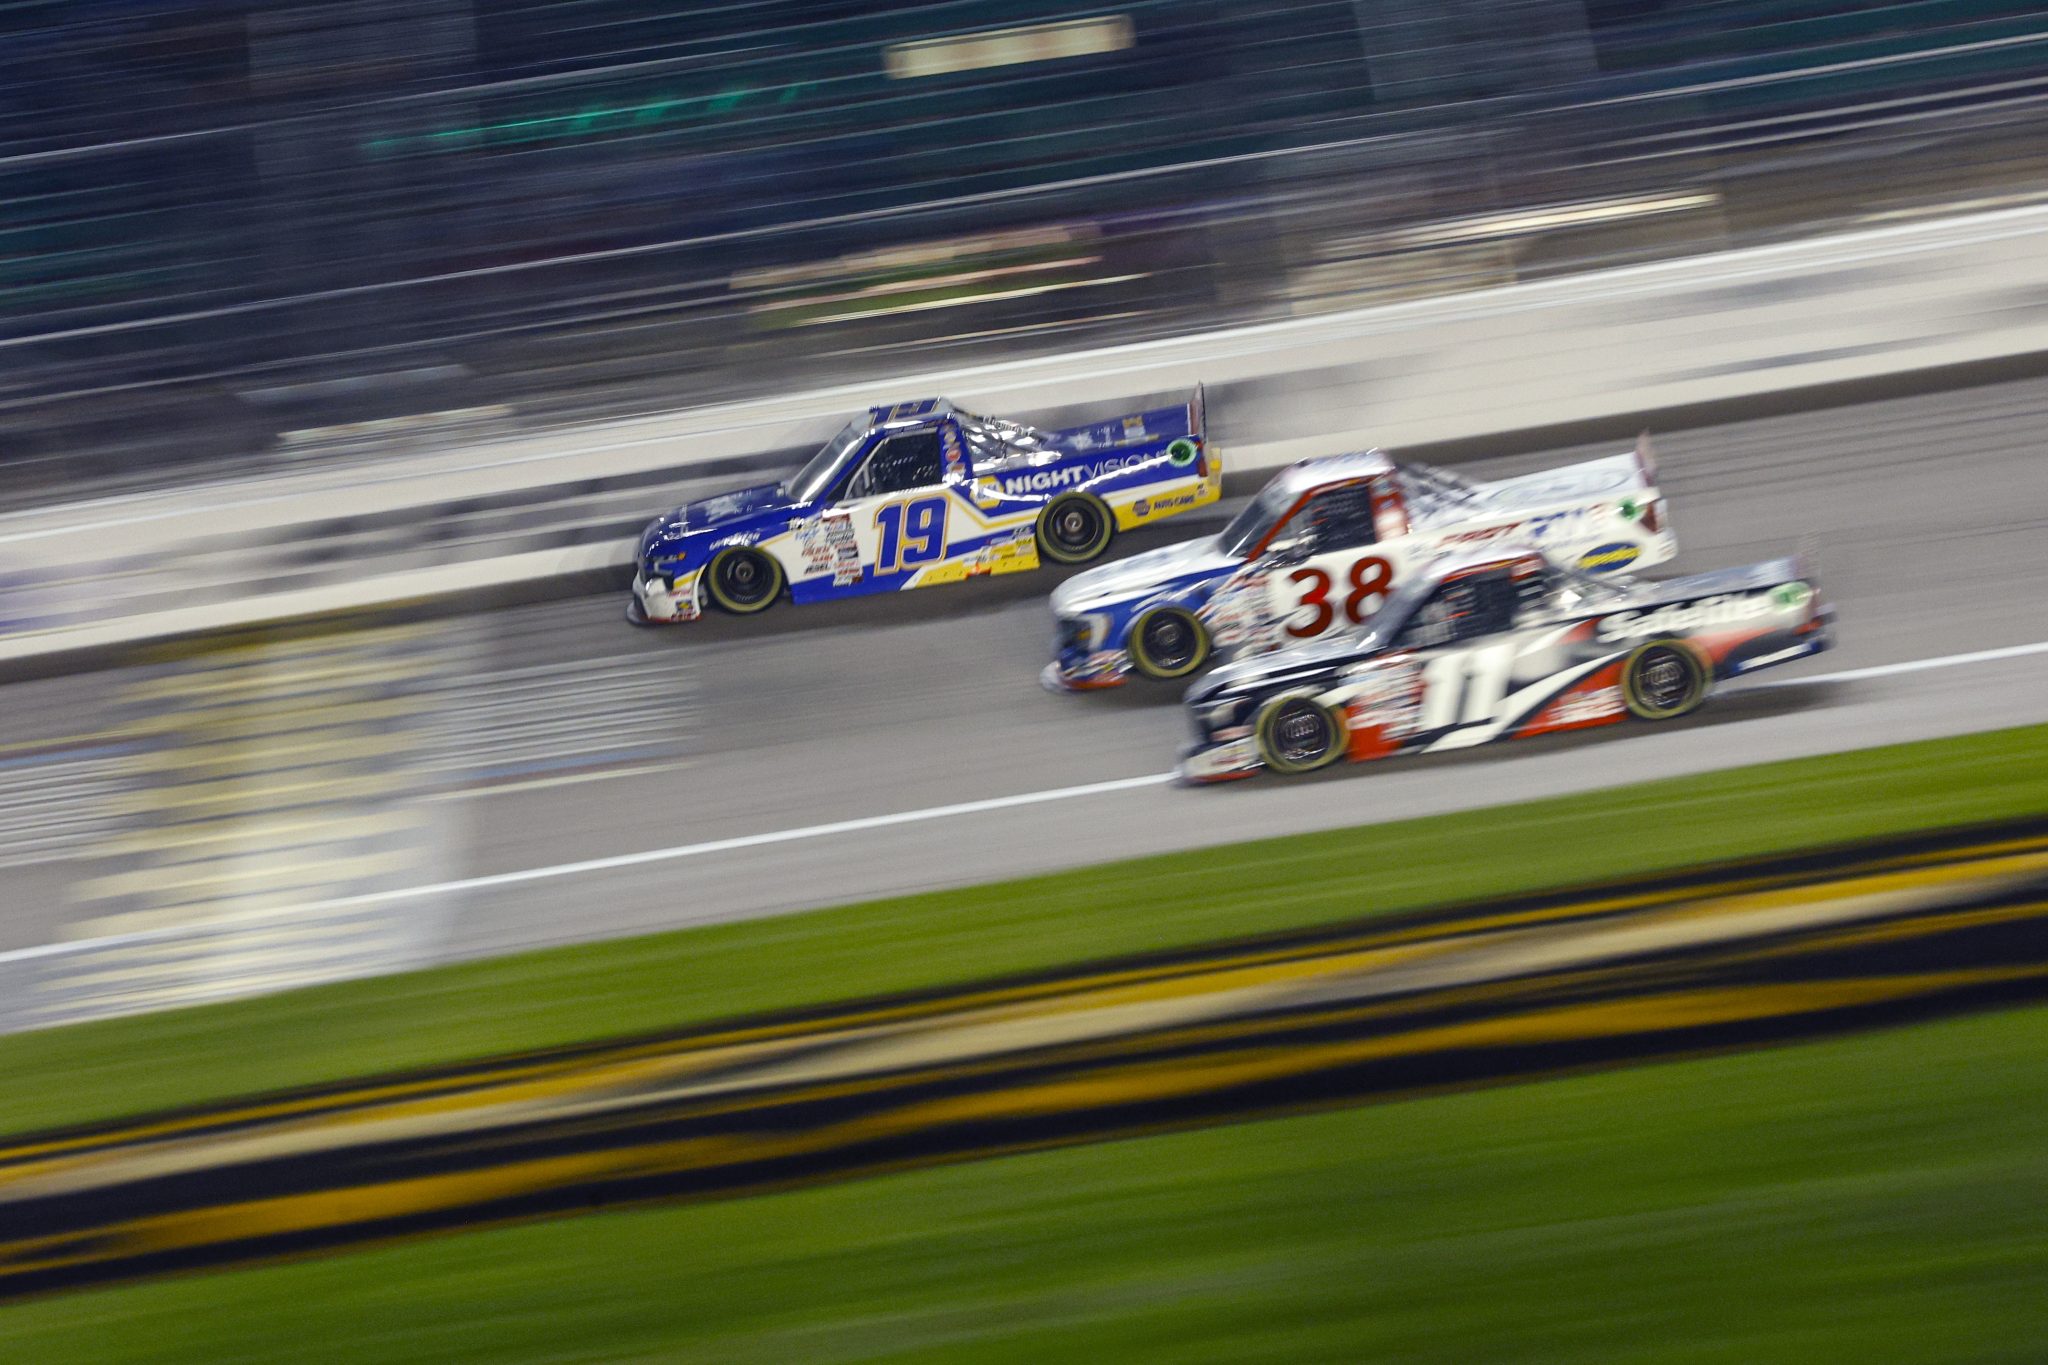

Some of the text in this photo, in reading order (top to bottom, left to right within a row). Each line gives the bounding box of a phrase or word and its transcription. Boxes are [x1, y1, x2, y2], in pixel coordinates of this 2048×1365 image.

[873, 493, 950, 576] 19
[1286, 556, 1393, 638] 38
[1423, 643, 1514, 730] 11
